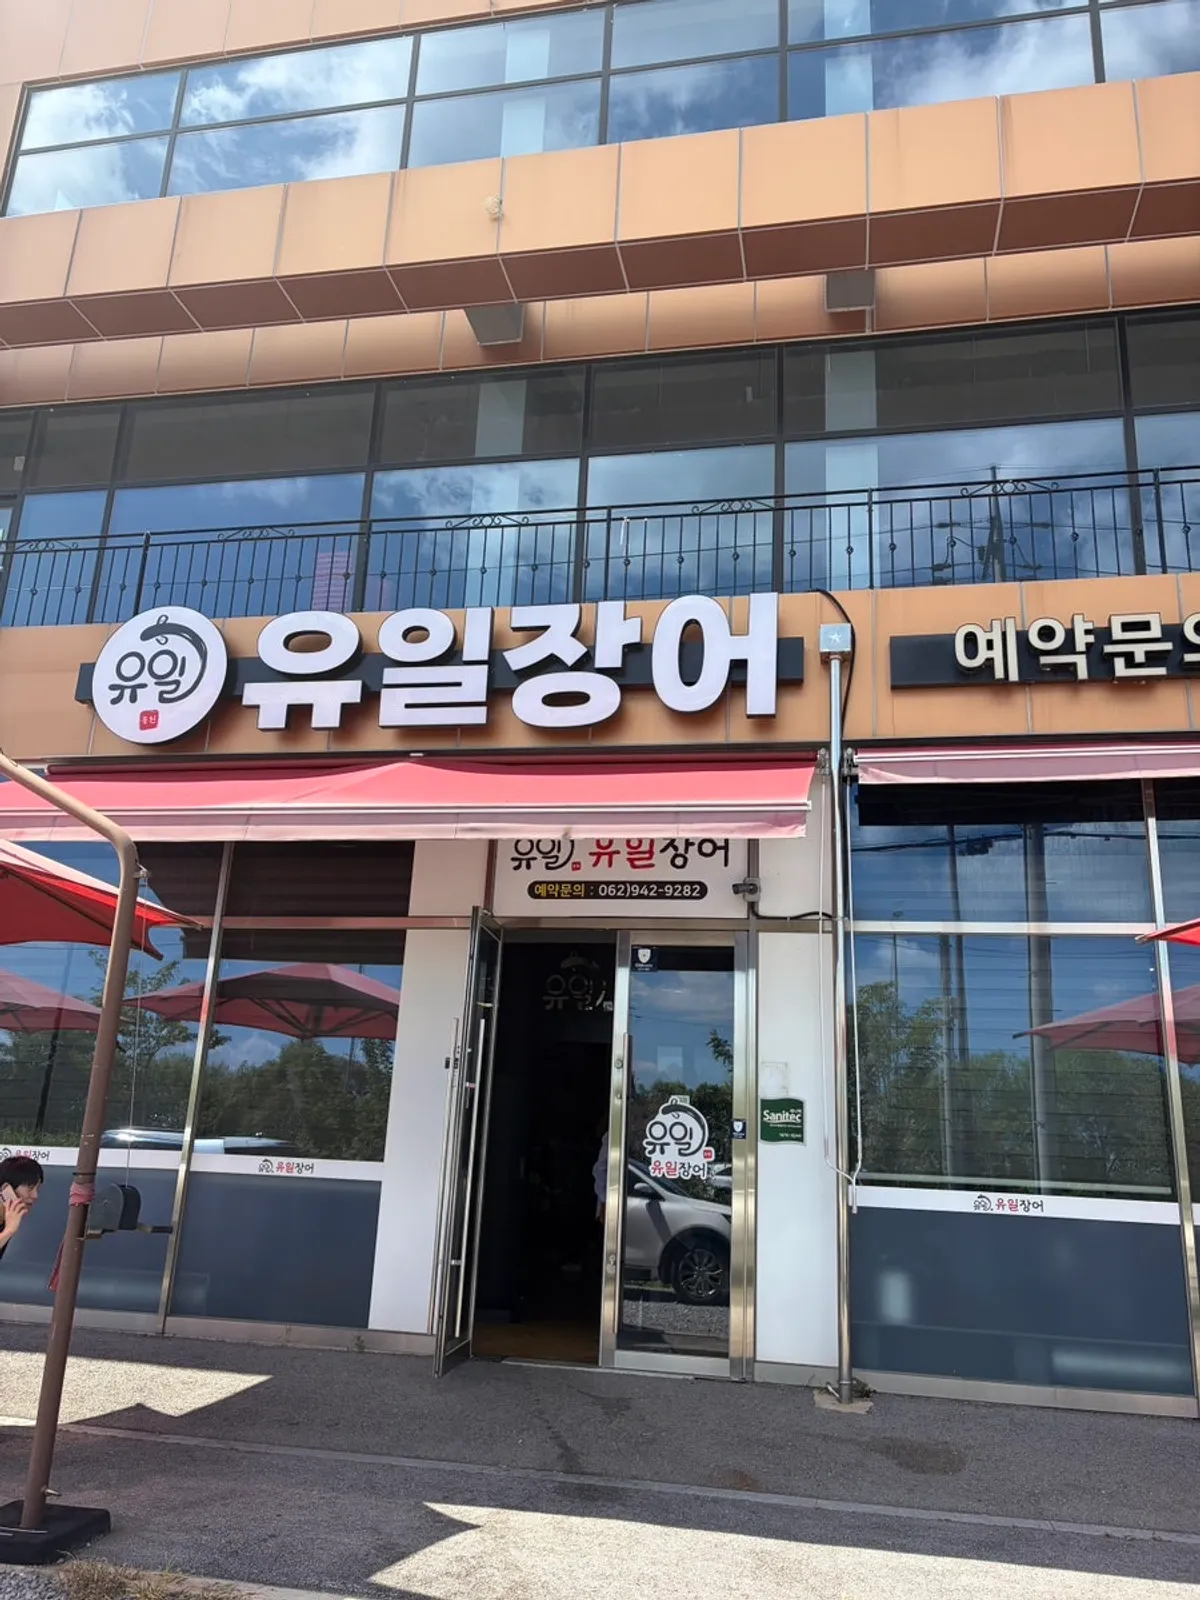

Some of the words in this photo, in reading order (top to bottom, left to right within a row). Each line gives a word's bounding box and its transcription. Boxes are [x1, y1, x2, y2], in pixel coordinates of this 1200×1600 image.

[242, 592, 779, 731] 유일장어
[954, 612, 1200, 682] 예약문
[108, 649, 190, 705] 유일
[510, 839, 566, 871] 유일
[588, 838, 729, 870] 유일장어
[534, 883, 585, 898] 예약문의
[598, 883, 701, 898] 062)942-9282
[763, 1109, 802, 1123] Sanitec
[643, 1121, 696, 1157] 유일
[275, 1161, 315, 1174] 유일장어
[651, 1161, 708, 1179] 유일장어
[995, 1198, 1044, 1213] 유일장어
